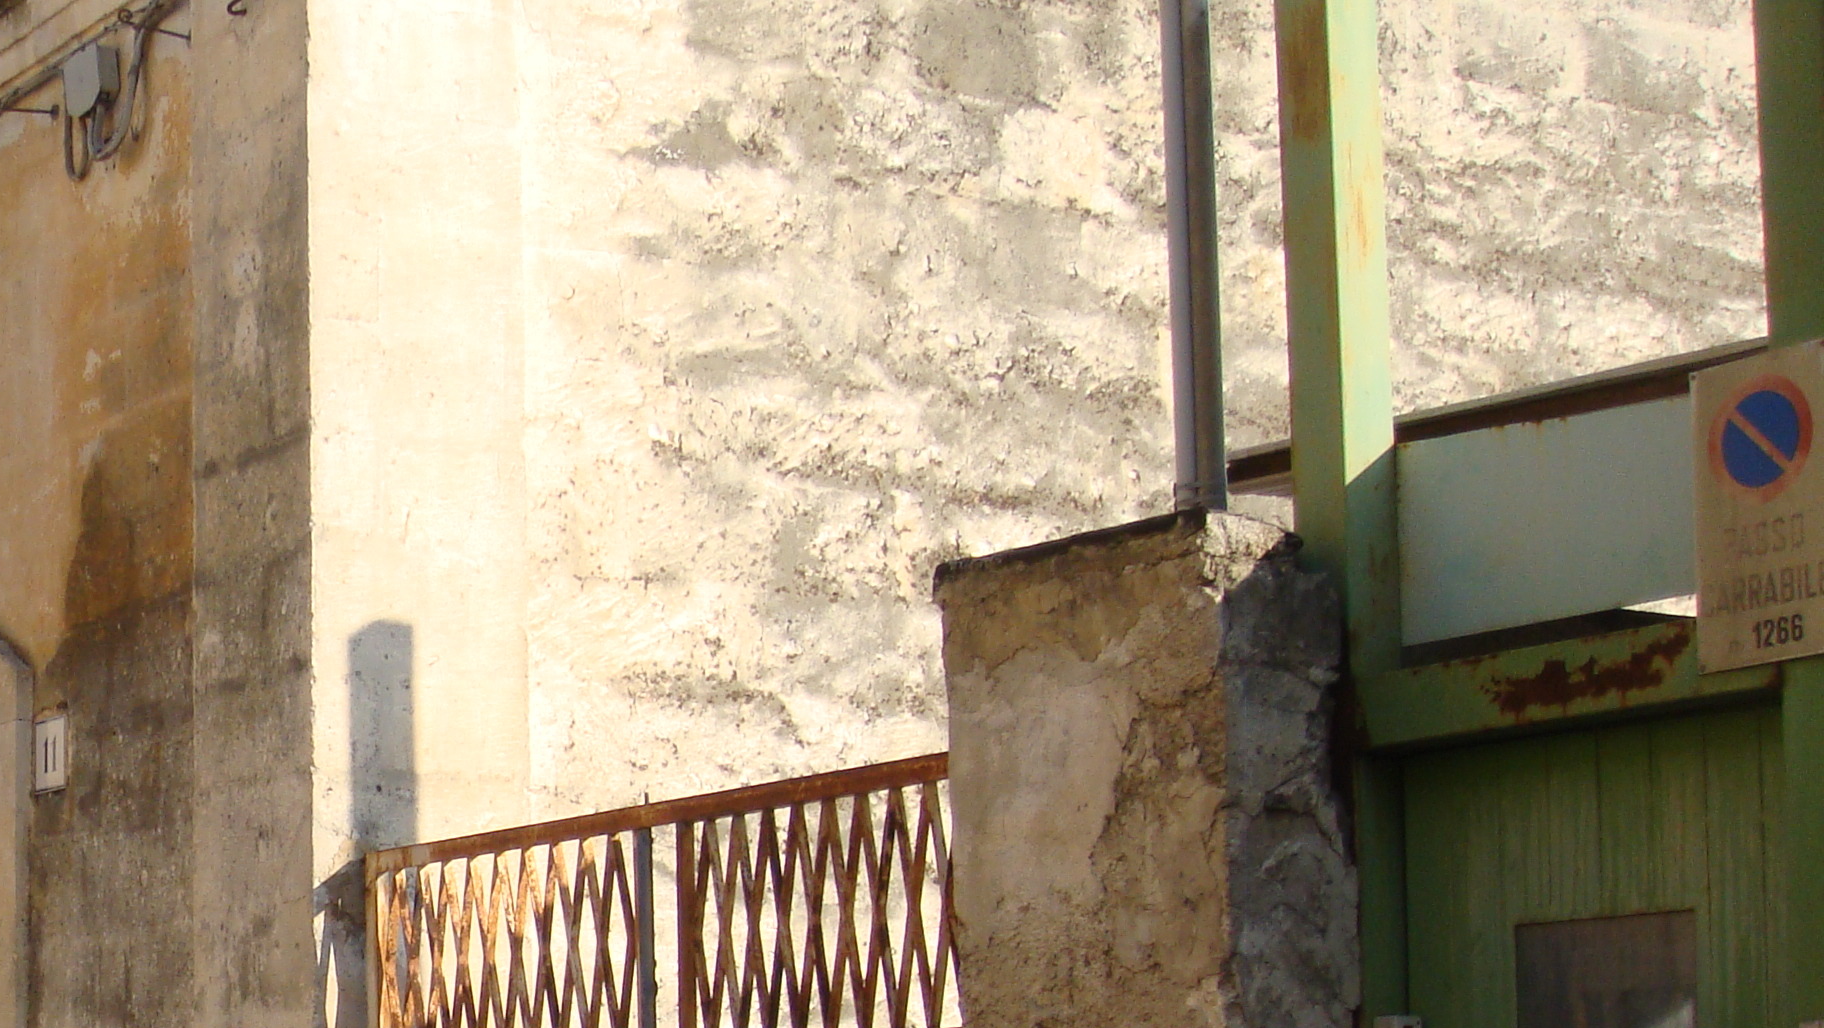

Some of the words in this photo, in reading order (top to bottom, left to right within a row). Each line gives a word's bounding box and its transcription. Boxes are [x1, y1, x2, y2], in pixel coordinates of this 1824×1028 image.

[1723, 511, 1805, 560] PASSO
[1752, 613, 1804, 649] 1266
[43, 736, 57, 774] 11
